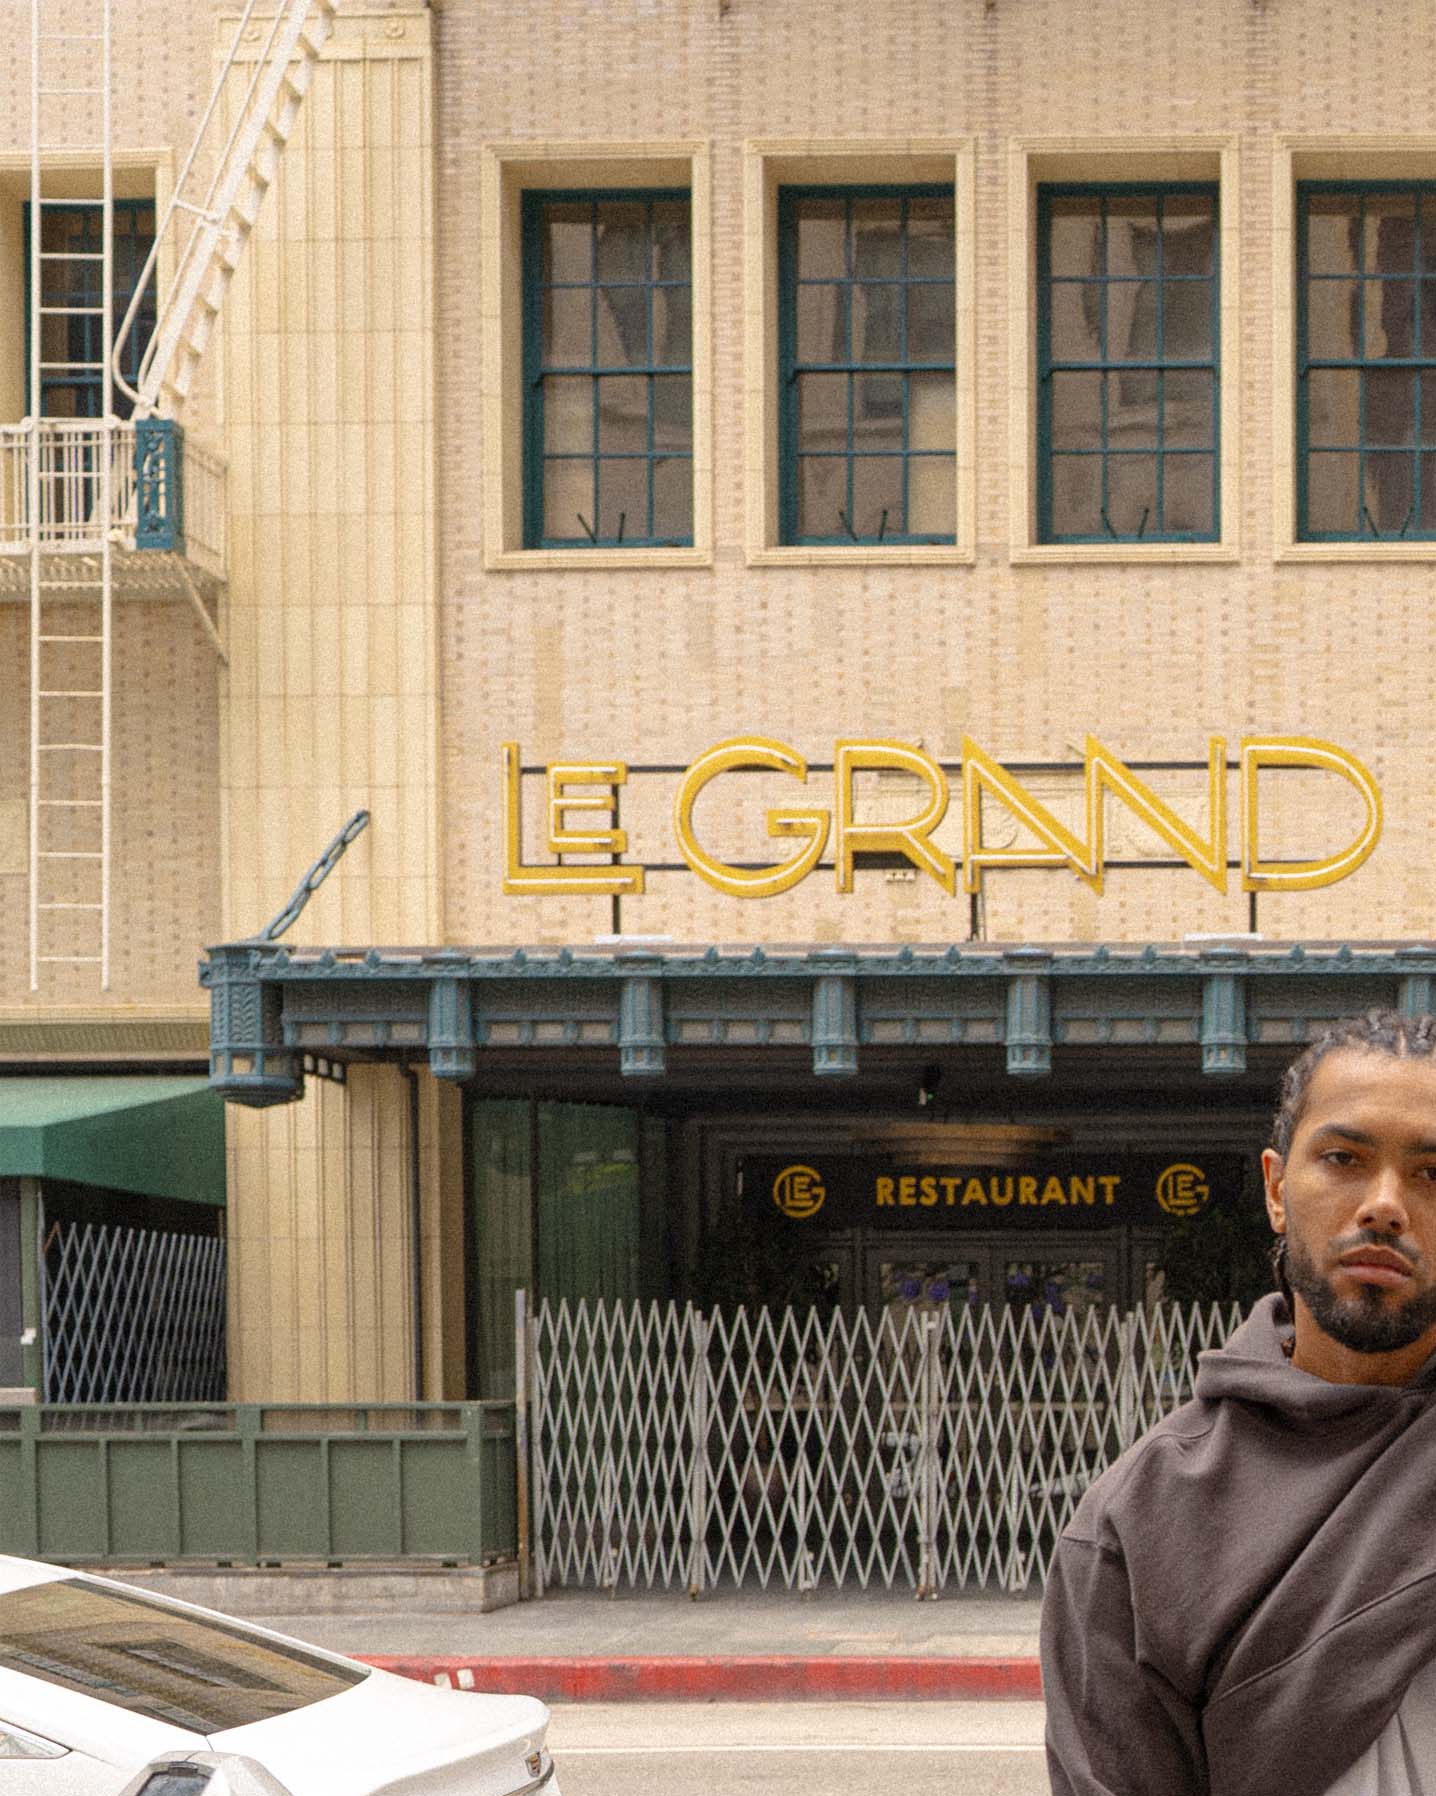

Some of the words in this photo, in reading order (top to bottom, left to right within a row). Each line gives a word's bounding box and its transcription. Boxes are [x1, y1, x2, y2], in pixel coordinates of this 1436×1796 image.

[502, 741, 645, 895] LE
[673, 733, 1384, 899] GRAND
[875, 1175, 1121, 1206] RESTAURANT
